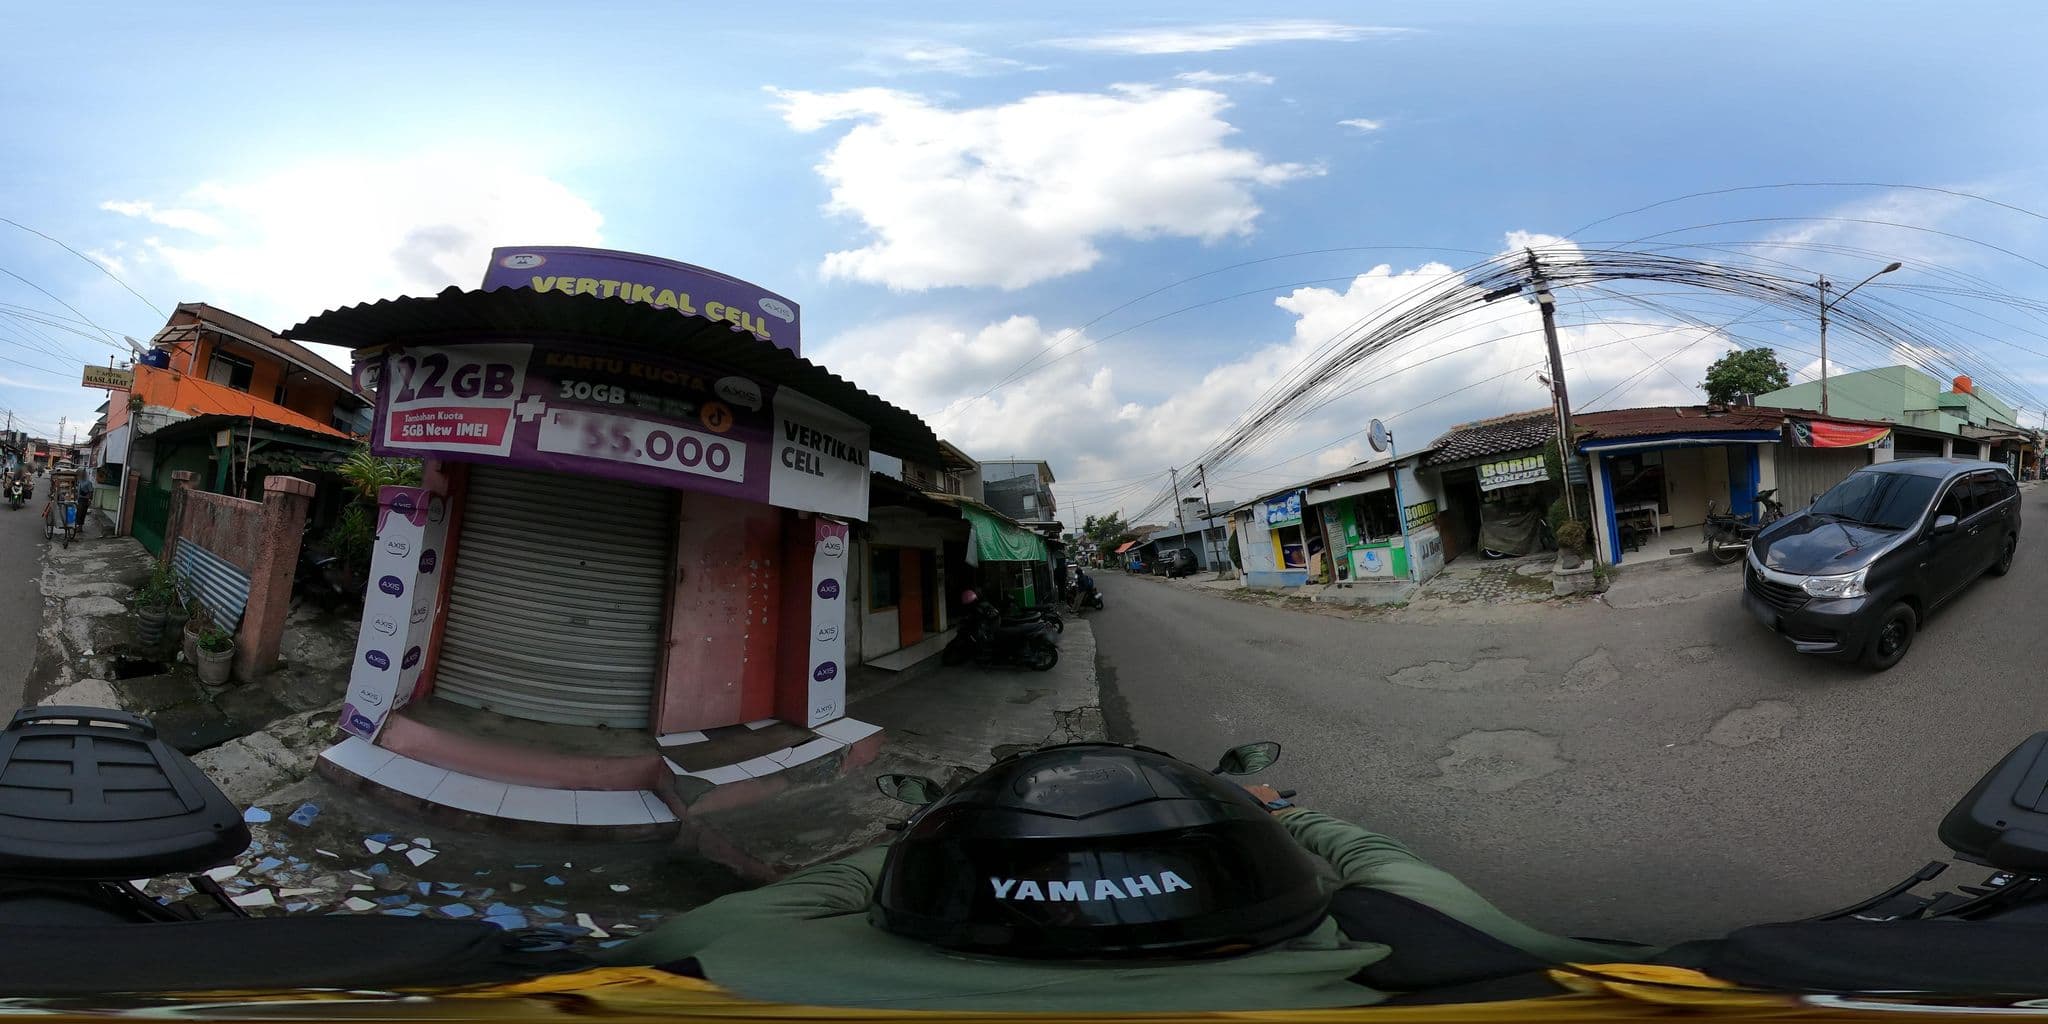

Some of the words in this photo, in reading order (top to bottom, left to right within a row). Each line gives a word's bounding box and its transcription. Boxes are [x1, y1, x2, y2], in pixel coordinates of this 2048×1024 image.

[531, 275, 697, 315] VERTIKAL
[703, 301, 772, 339] CELL
[763, 301, 791, 319] AXIS
[545, 351, 624, 376] KARTU
[629, 360, 706, 392] KUOTA
[559, 379, 626, 405] 30GB
[722, 385, 757, 402] AXIS
[404, 411, 436, 423] Tambahan
[437, 410, 464, 421] Kuota
[401, 424, 424, 437] 5GB
[425, 422, 453, 437] New
[456, 422, 489, 438] IMEI
[783, 419, 866, 467] VERTIKAL
[781, 446, 825, 477] CELL
[1482, 453, 1546, 477] BORDI
[388, 541, 407, 551] AXIS
[824, 542, 841, 551] AXIS
[381, 580, 401, 592] AXIS
[820, 584, 837, 594] AXIS
[413, 606, 427, 617] AXIS
[375, 619, 394, 630] AXIS
[818, 627, 836, 637] AXIS
[368, 653, 388, 667] AXIS
[816, 667, 835, 679] AXIS
[360, 689, 379, 702] AXIS
[815, 703, 834, 715] AXIS
[353, 717, 373, 732] AXIS
[988, 870, 1193, 902] YAMAHA
